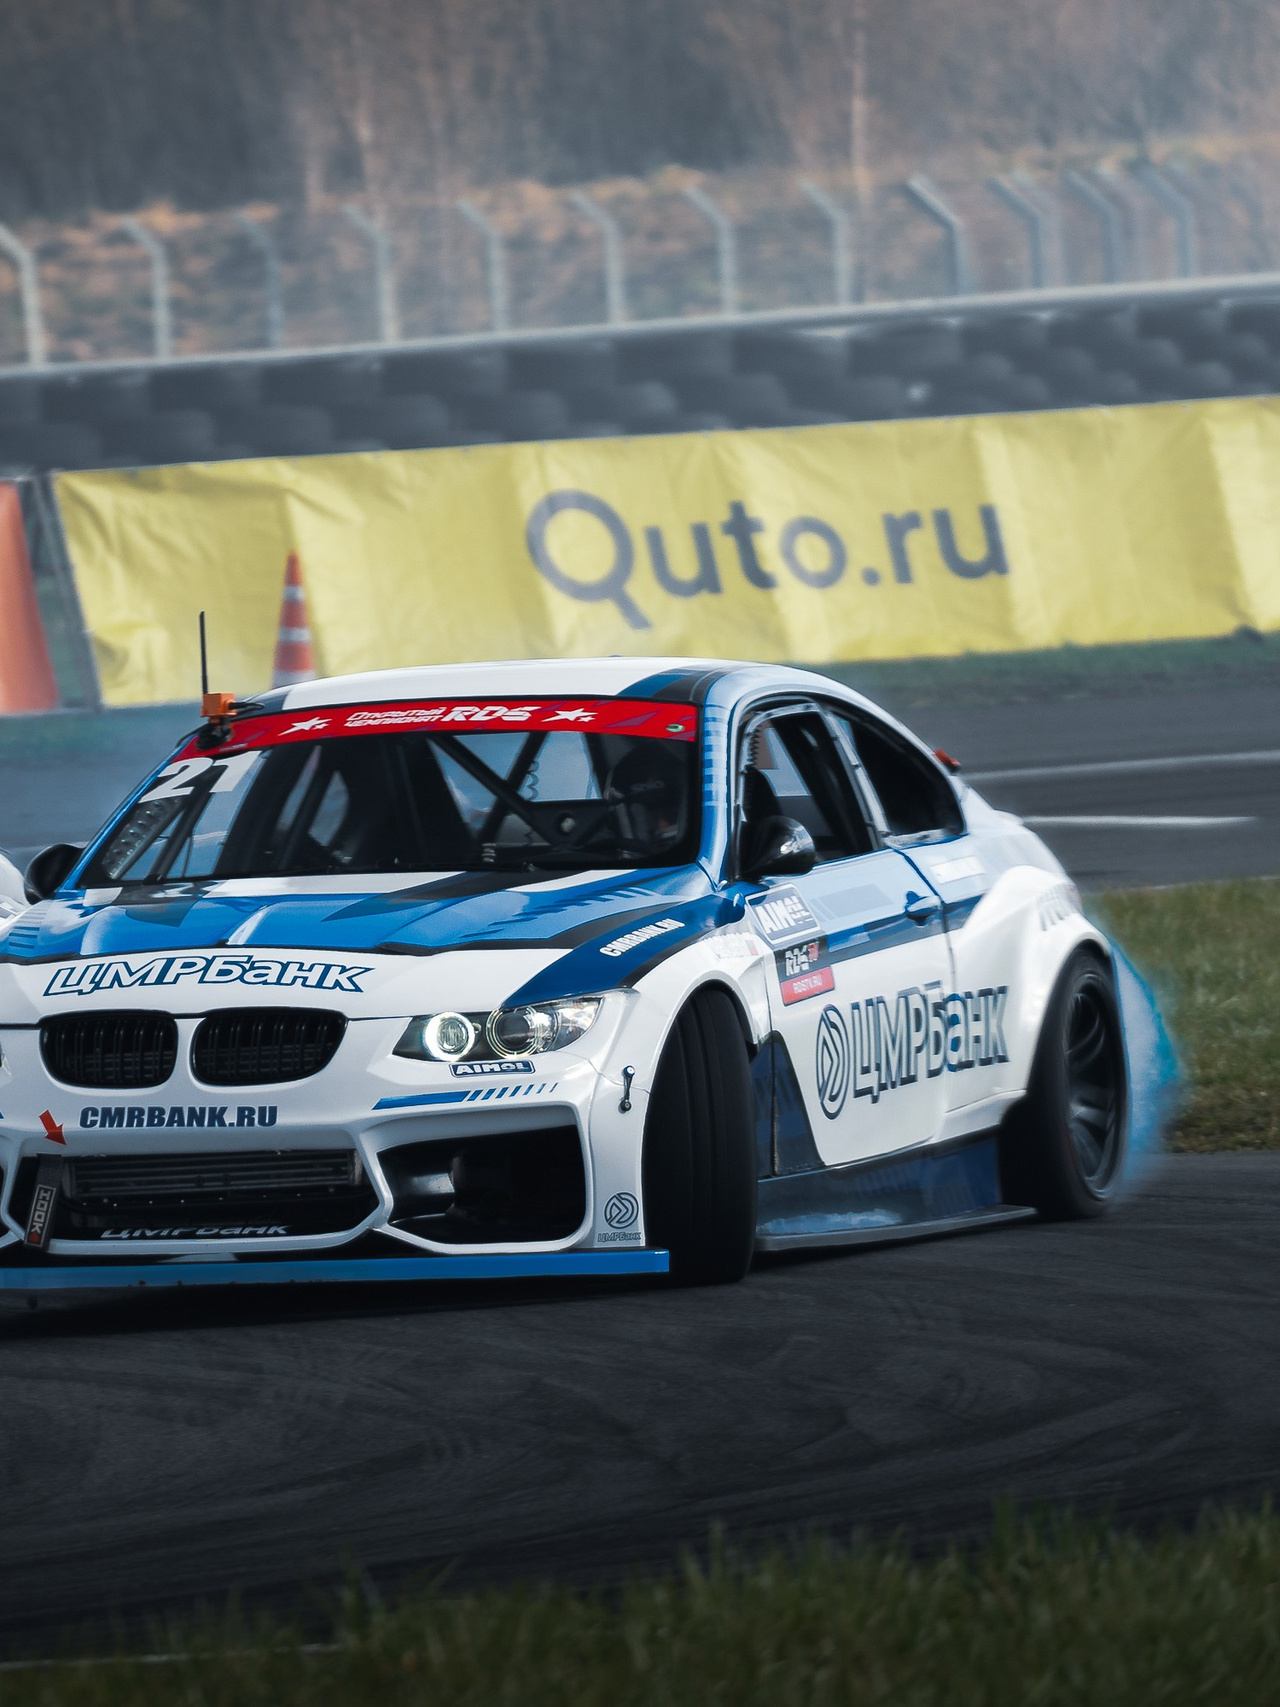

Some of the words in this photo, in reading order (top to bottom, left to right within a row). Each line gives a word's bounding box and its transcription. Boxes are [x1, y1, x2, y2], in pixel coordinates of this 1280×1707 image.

[525, 488, 1010, 632] Quto.ru
[440, 705, 542, 722] RDS
[137, 750, 263, 804] 21
[599, 918, 686, 957] CMRBANK.RU
[42, 955, 376, 997] ЦМРБанк
[850, 979, 1010, 1105] ЦМРБанк
[78, 1104, 278, 1129] CMRBANK.RU
